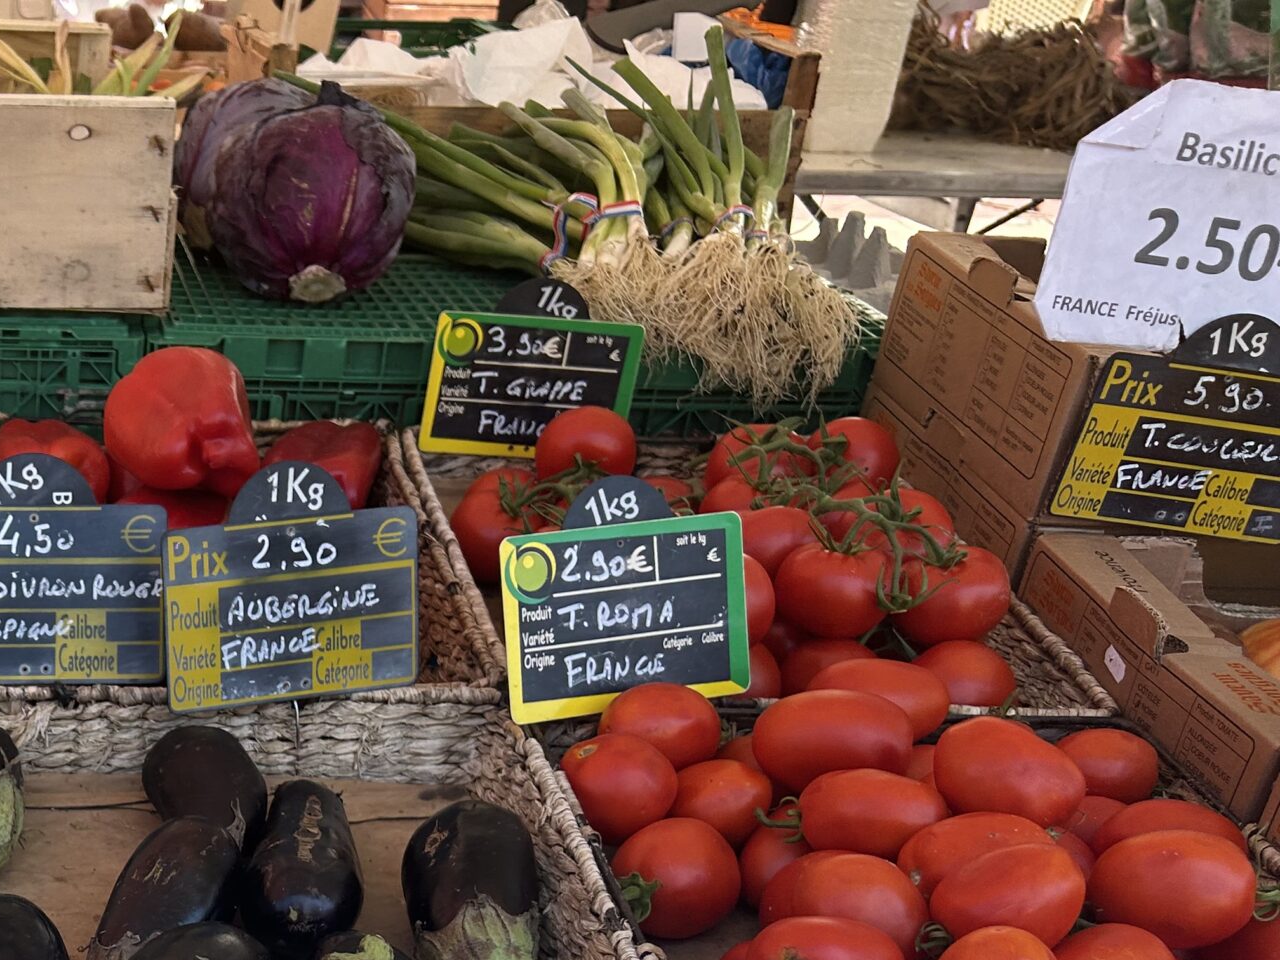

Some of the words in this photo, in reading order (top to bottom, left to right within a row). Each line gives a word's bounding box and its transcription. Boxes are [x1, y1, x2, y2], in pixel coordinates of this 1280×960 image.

[1176, 131, 1280, 176] Basilic
[1134, 207, 1280, 282] 2.50
[1052, 295, 1119, 318] FRANCE
[1125, 304, 1178, 327] Fréjus
[444, 366, 471, 379] Produit
[1099, 359, 1163, 406] Prix
[438, 401, 465, 417] Origine
[478, 409, 546, 437] FRANC
[1081, 416, 1131, 449] Produit
[1071, 457, 1113, 484] Variété
[1116, 463, 1212, 491] FRANCE
[1057, 484, 1101, 515] Origine
[1205, 474, 1249, 502] Calibre
[584, 488, 640, 526] 1kg
[1192, 501, 1246, 535] Catégorie
[120, 514, 157, 553] €
[373, 517, 407, 558] €
[676, 532, 689, 546] soit
[690, 533, 697, 544] le
[697, 531, 707, 546] kg
[167, 535, 230, 581] Prix
[706, 547, 721, 562] €
[170, 600, 219, 632] Produit
[521, 605, 553, 622] Produit
[221, 628, 319, 670] FRANCE
[316, 622, 361, 652] Calibre
[521, 628, 556, 648] Variété
[662, 634, 693, 651] Catégorie
[701, 631, 725, 644] Calibre
[59, 643, 115, 678] Catégorie
[172, 644, 217, 672] Variété
[315, 655, 369, 689] Catégorie
[524, 653, 556, 672] Origine
[173, 675, 219, 706] Origine
